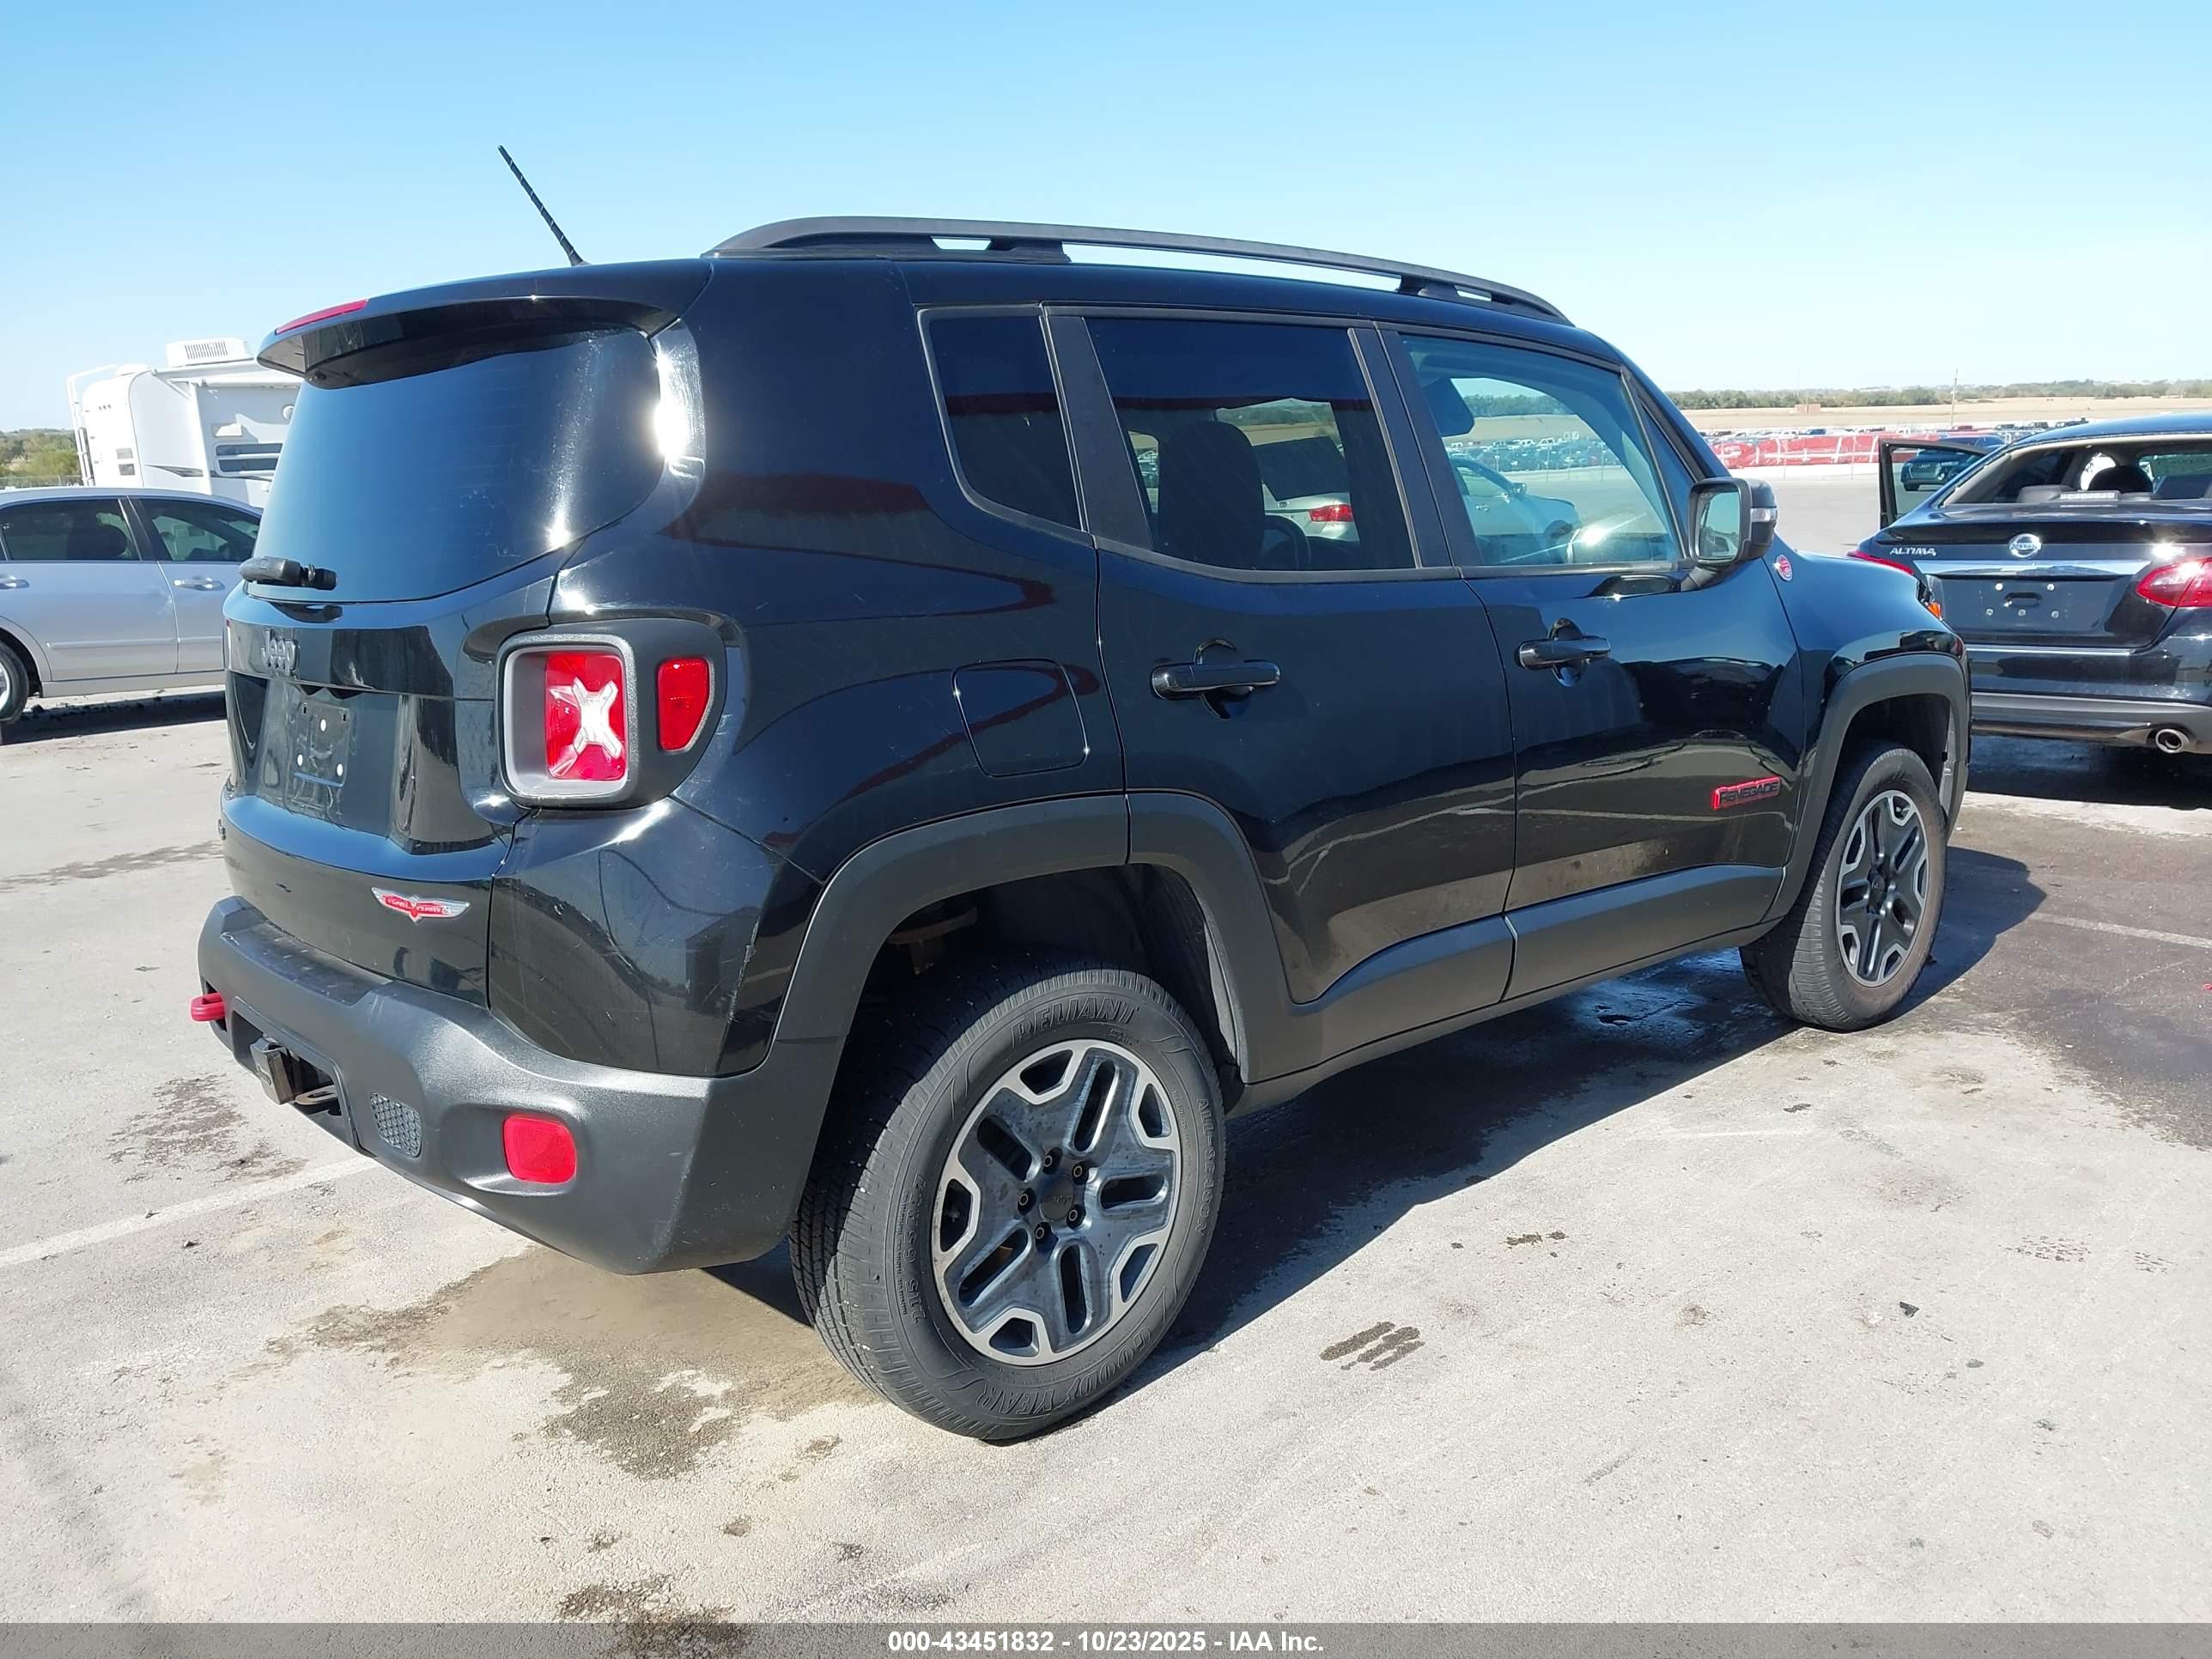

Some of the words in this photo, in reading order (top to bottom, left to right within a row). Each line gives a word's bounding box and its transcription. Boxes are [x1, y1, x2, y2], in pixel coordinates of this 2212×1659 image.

[1889, 546, 1937, 556] ALTIMA
[260, 629, 296, 676] Jeep
[1010, 997, 1139, 1050] RELIANT
